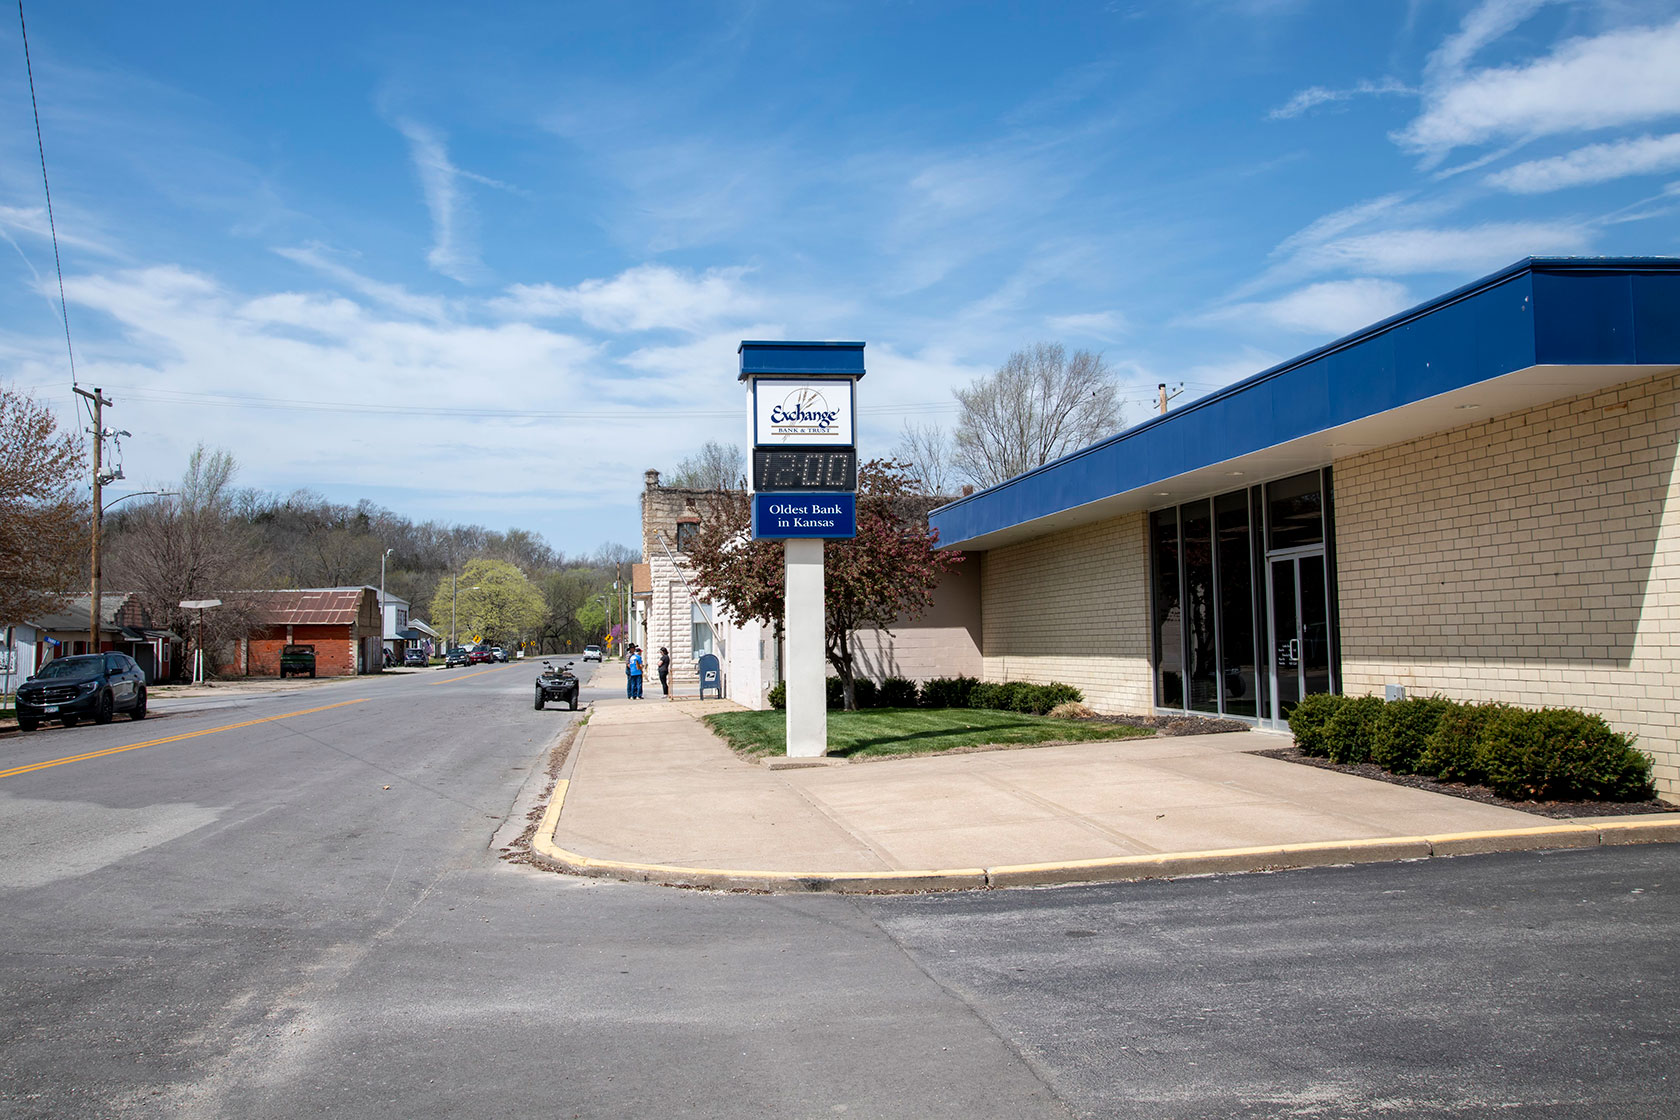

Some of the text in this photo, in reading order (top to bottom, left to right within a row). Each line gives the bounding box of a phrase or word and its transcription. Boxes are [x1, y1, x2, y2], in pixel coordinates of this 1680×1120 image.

[771, 404, 840, 428] Exchange
[762, 454, 848, 487] 12:00
[769, 504, 843, 515] Oldest Bank
[778, 517, 835, 528] in Kansas
